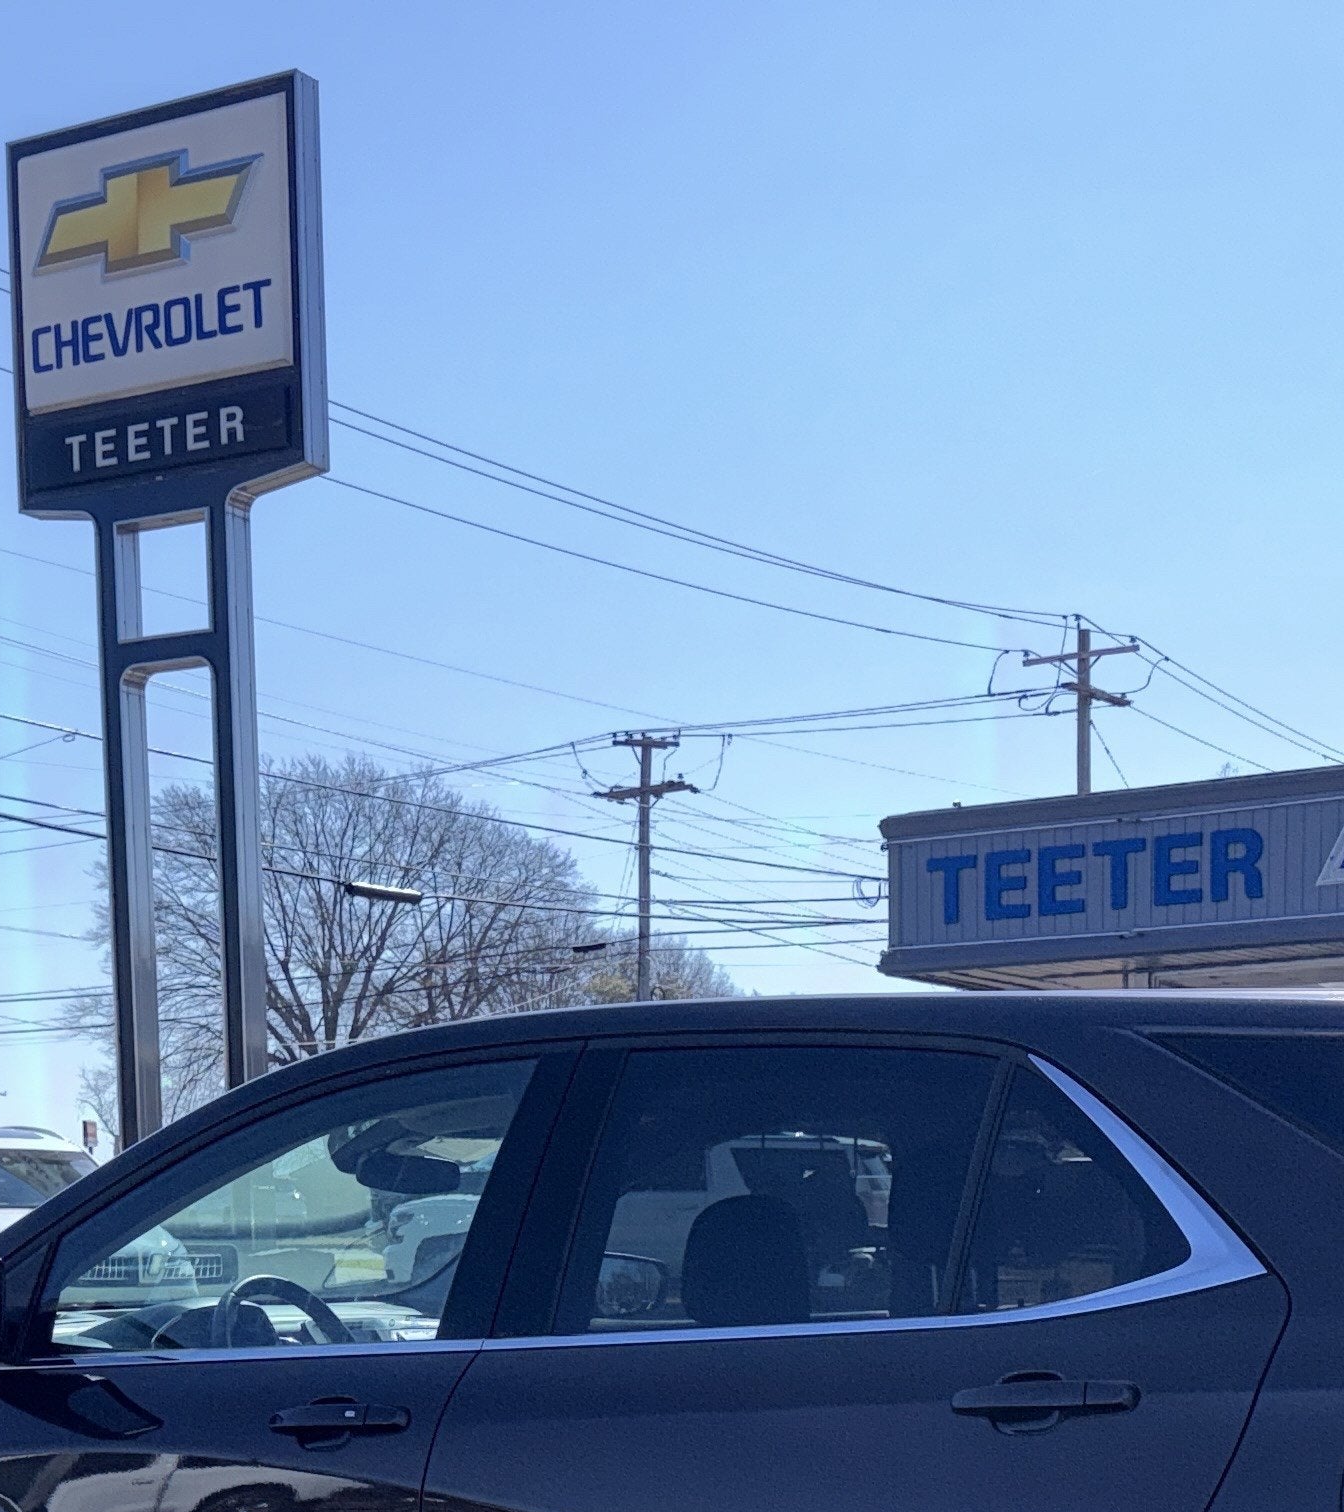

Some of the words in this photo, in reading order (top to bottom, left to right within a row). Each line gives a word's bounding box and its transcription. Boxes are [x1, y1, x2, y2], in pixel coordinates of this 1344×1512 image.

[31, 278, 272, 374] CHEVROLET
[64, 404, 245, 473] TEETER
[926, 827, 1264, 926] TEETER
